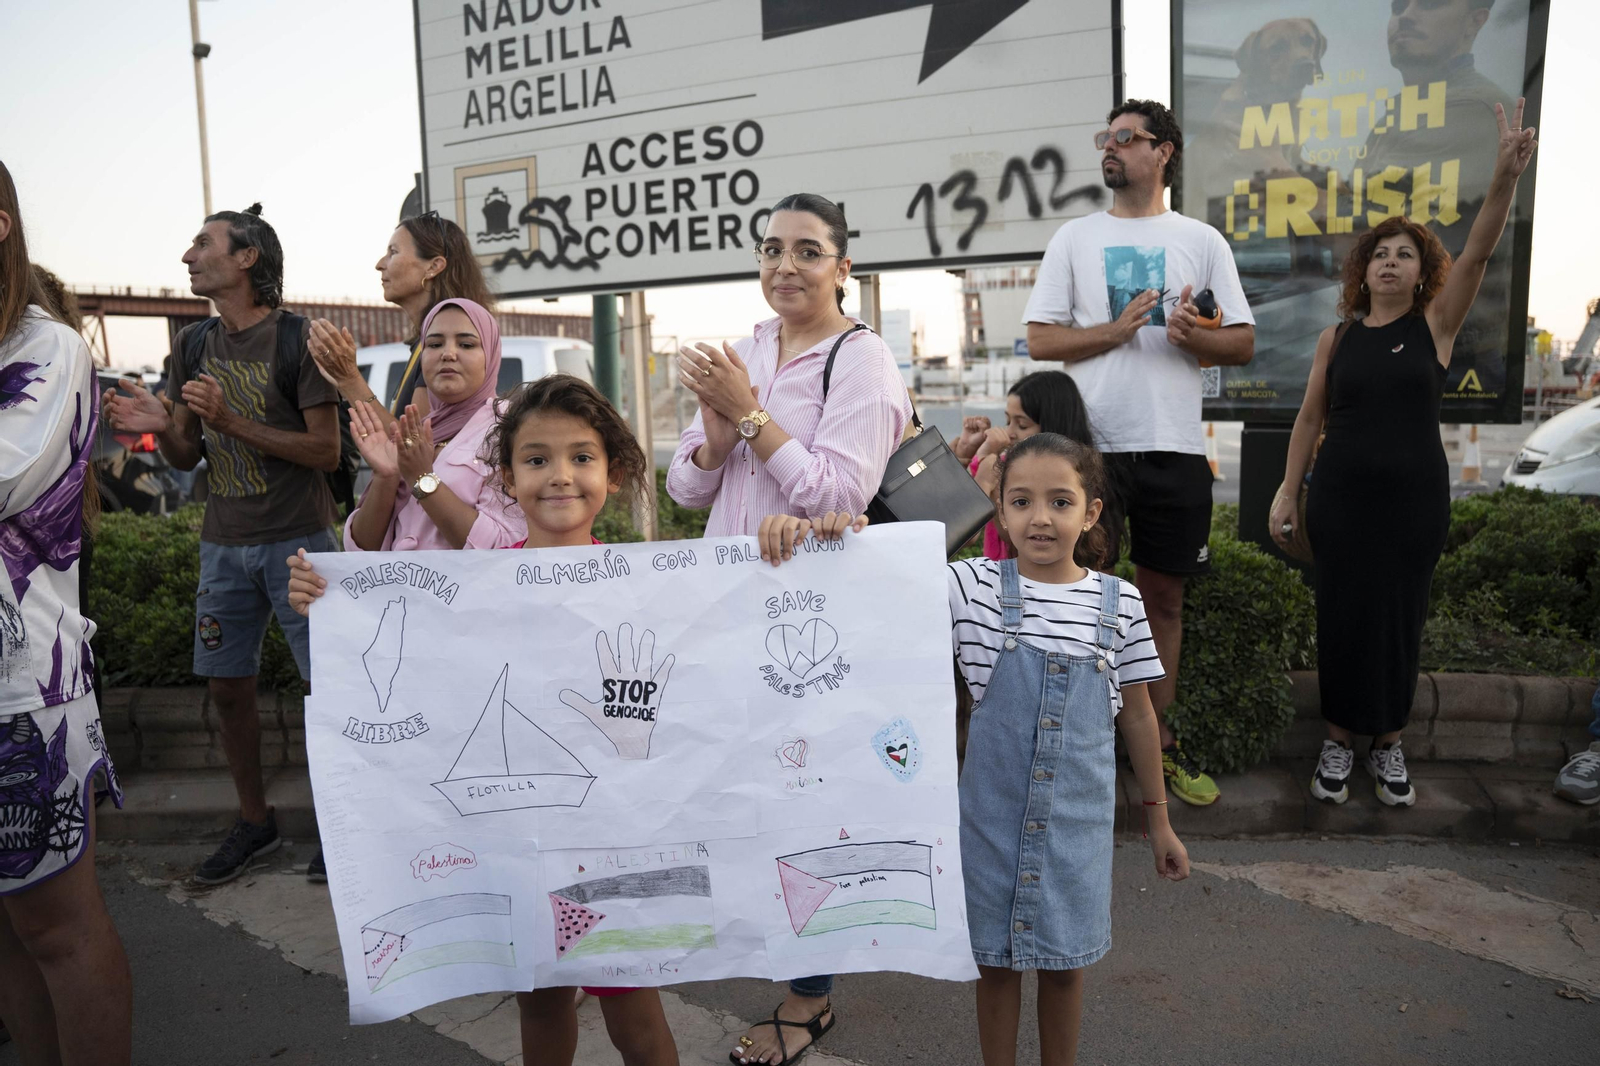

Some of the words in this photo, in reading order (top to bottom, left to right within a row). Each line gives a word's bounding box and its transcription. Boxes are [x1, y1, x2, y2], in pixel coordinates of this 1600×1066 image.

[465, 15, 632, 79] MELILLA
[463, 65, 616, 129] ARGELIA
[1338, 68, 1366, 85] UN
[1239, 81, 1447, 150] MATCH
[581, 120, 764, 178] ACCESO
[1309, 147, 1341, 163] SOY
[1348, 145, 1367, 160] TU
[585, 169, 760, 222] PUERTO
[906, 145, 1105, 256] 1312
[1225, 158, 1461, 241] CRUSH
[584, 203, 860, 260] COMERC
[340, 561, 460, 605] PALESTINA
[516, 549, 631, 585] ALMERÍA
[652, 549, 698, 571] CON
[715, 535, 845, 565] PALINA
[602, 678, 658, 706] STOP
[342, 712, 430, 744] LIBRE
[467, 781, 536, 799] FLOTILLA
[596, 842, 709, 868] PALESTINA
